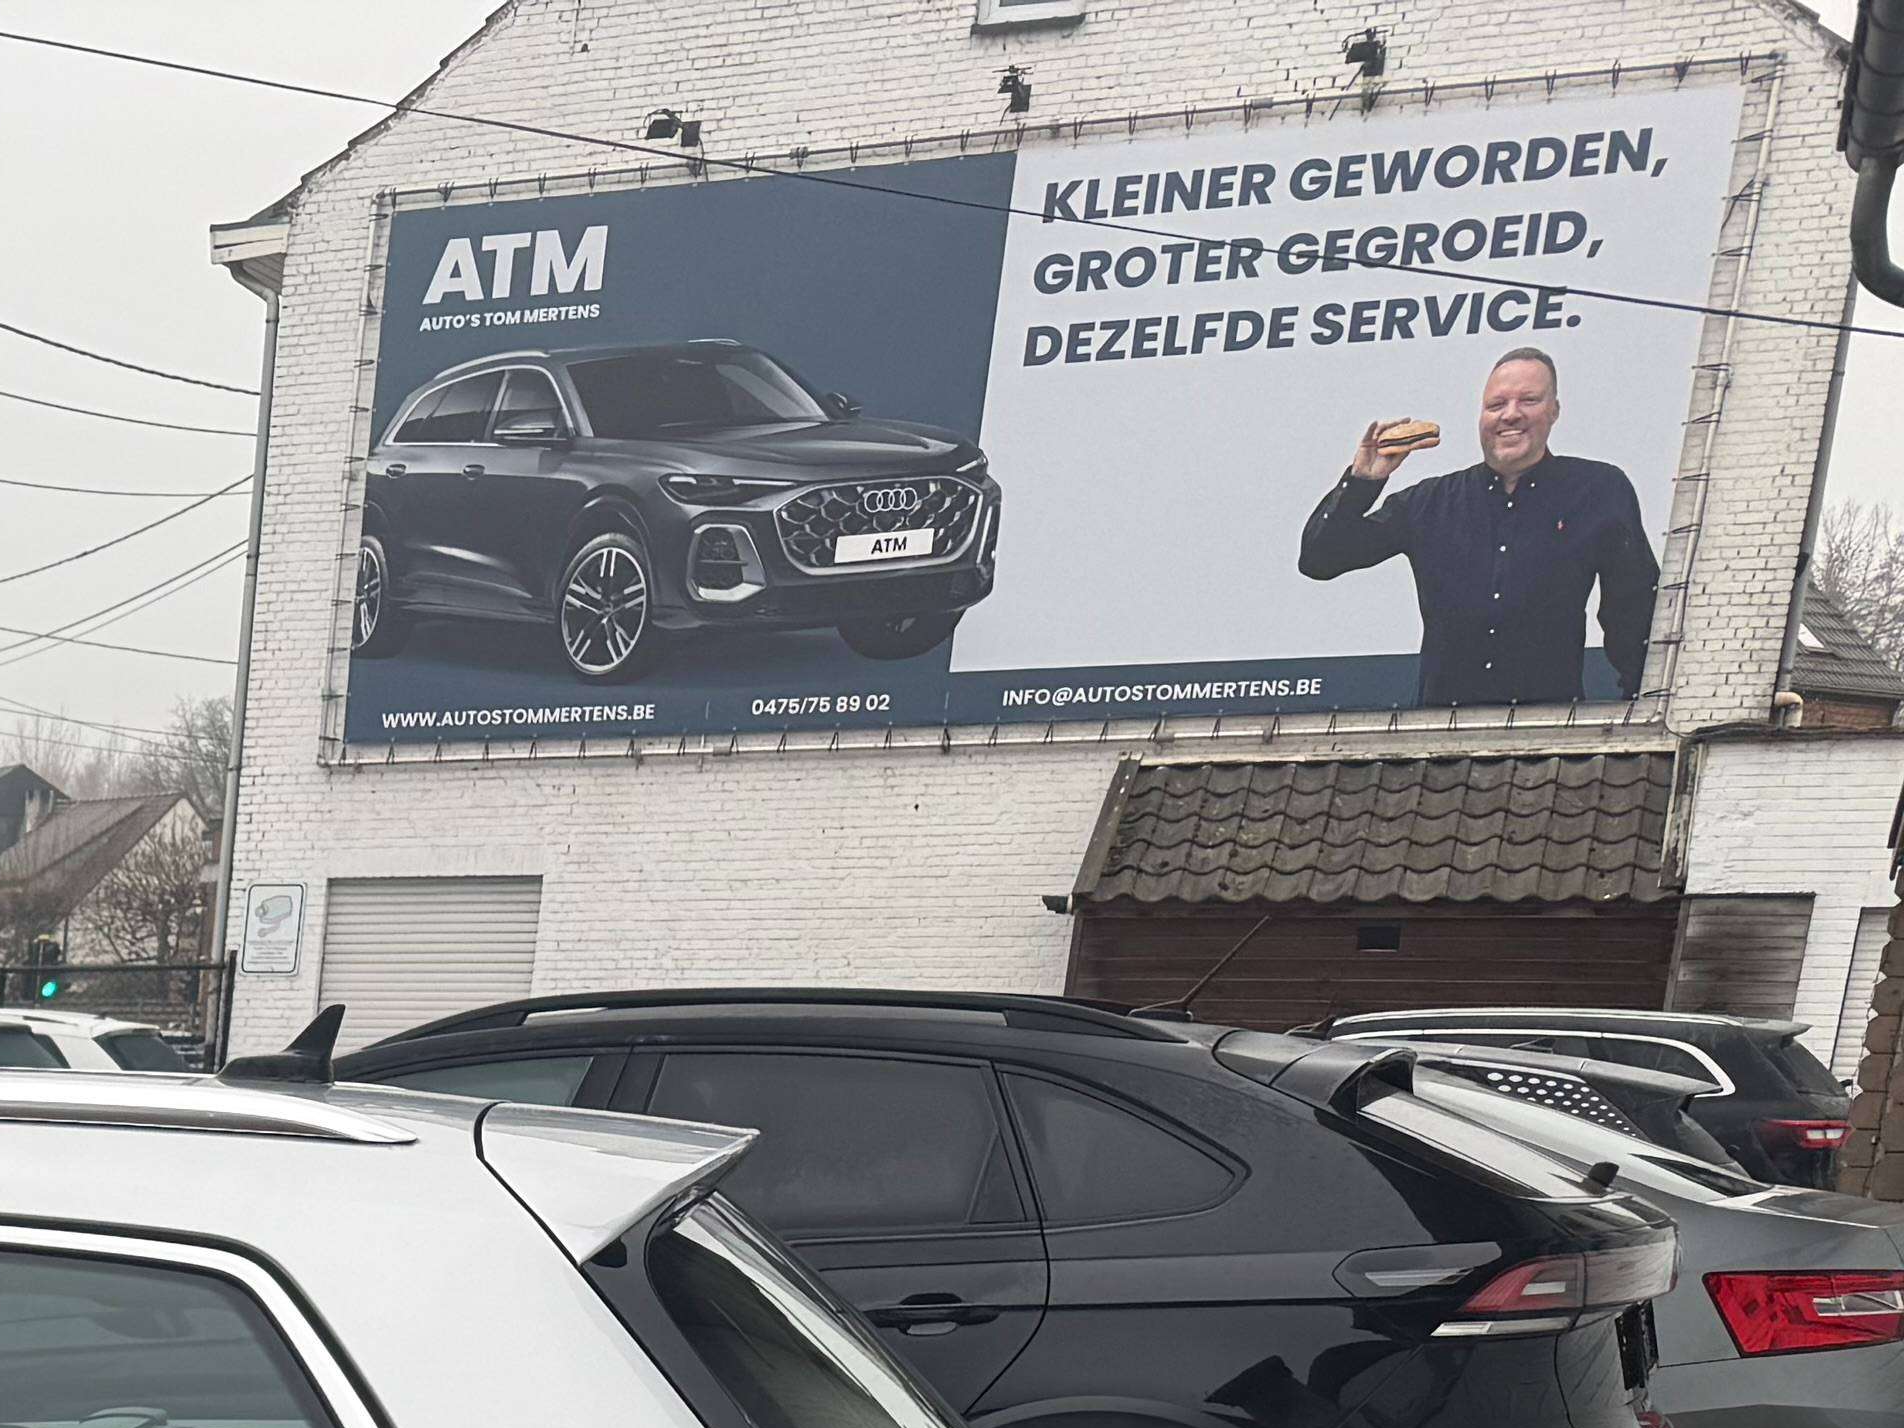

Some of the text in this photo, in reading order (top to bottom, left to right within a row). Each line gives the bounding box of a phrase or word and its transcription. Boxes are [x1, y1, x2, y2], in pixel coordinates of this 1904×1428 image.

[1042, 127, 1669, 223] KLEINER GEWORDEN,
[422, 225, 609, 304] ATM
[1033, 210, 1604, 295] GROTER GEGROEID,
[419, 304, 601, 332] AUTO'S TOM MERTENS
[1023, 286, 1582, 367] DEZELFDE SERVICE.
[871, 536, 907, 555] ATM
[751, 694, 891, 716] 0475/75 89 02
[1002, 678, 1322, 706] INFO@AUTOSTOMMERTENS.BE
[382, 703, 656, 729] WWW.AUTOSTOMMERTENS.BE
